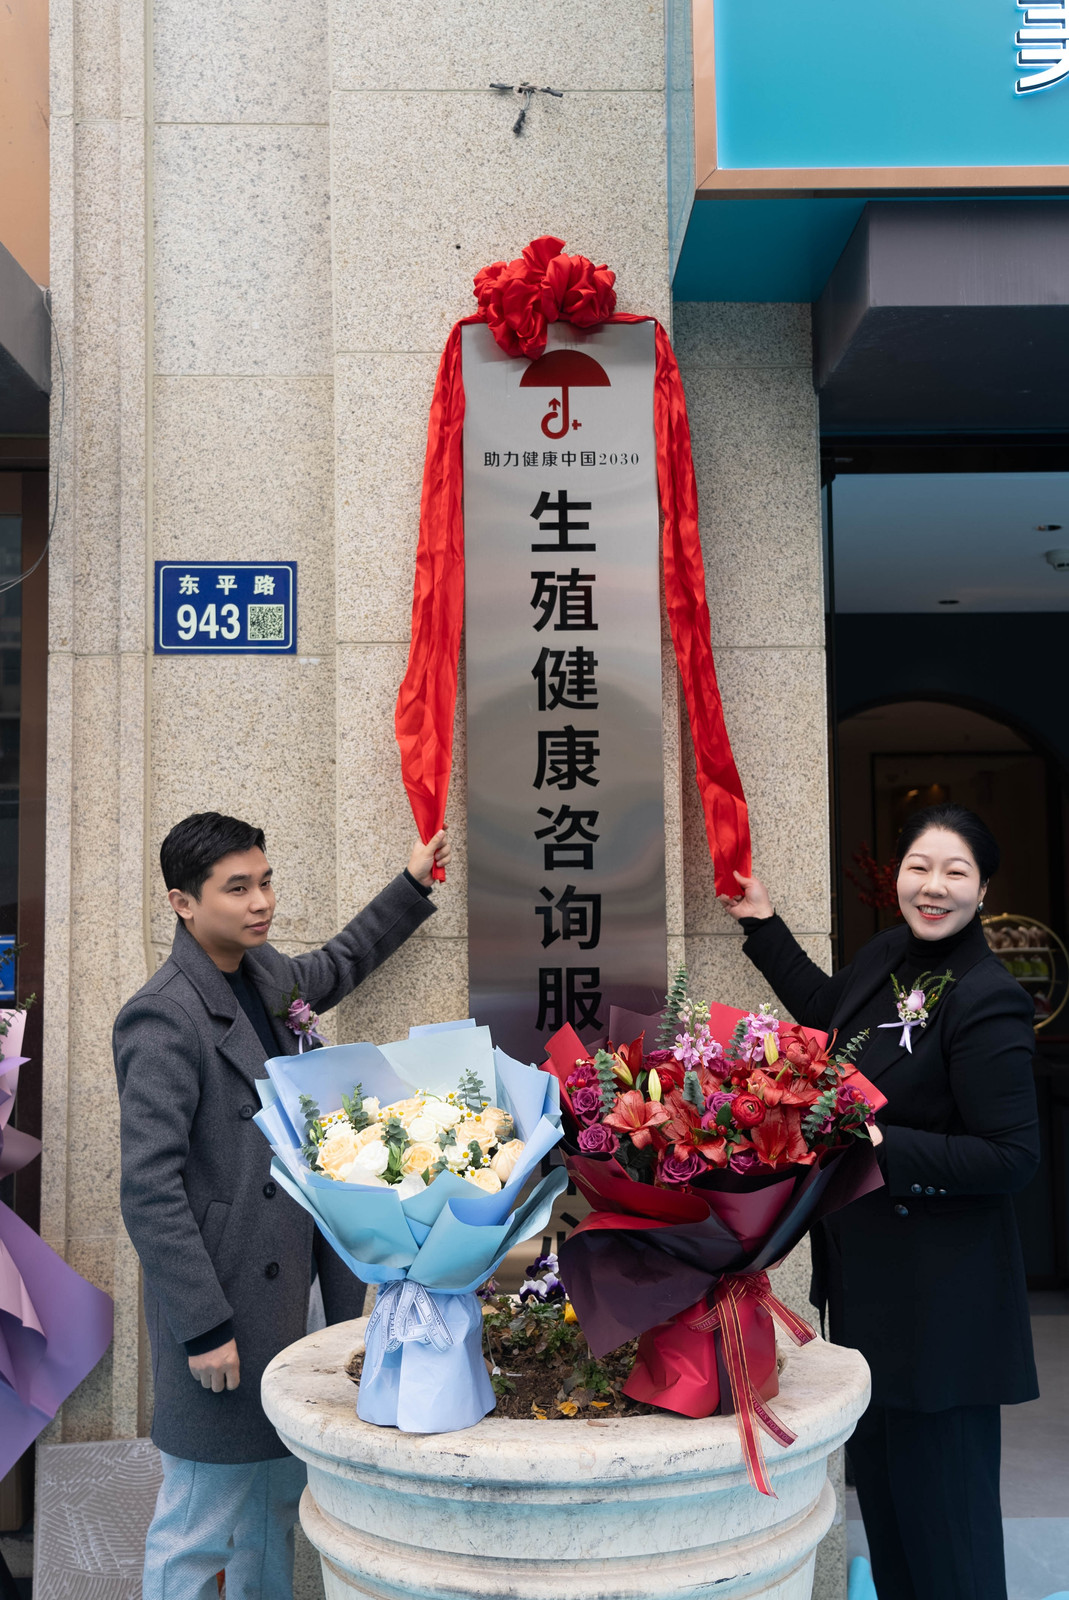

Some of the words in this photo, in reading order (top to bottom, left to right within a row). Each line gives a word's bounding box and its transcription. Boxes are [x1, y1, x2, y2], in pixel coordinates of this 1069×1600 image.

[484, 451, 640, 467] 助力健康中国2030
[178, 574, 276, 596] 东平路
[176, 603, 241, 641] 943
[530, 490, 604, 1257] 生殖健康咨询服
[767, 1419, 780, 1434] FOR
